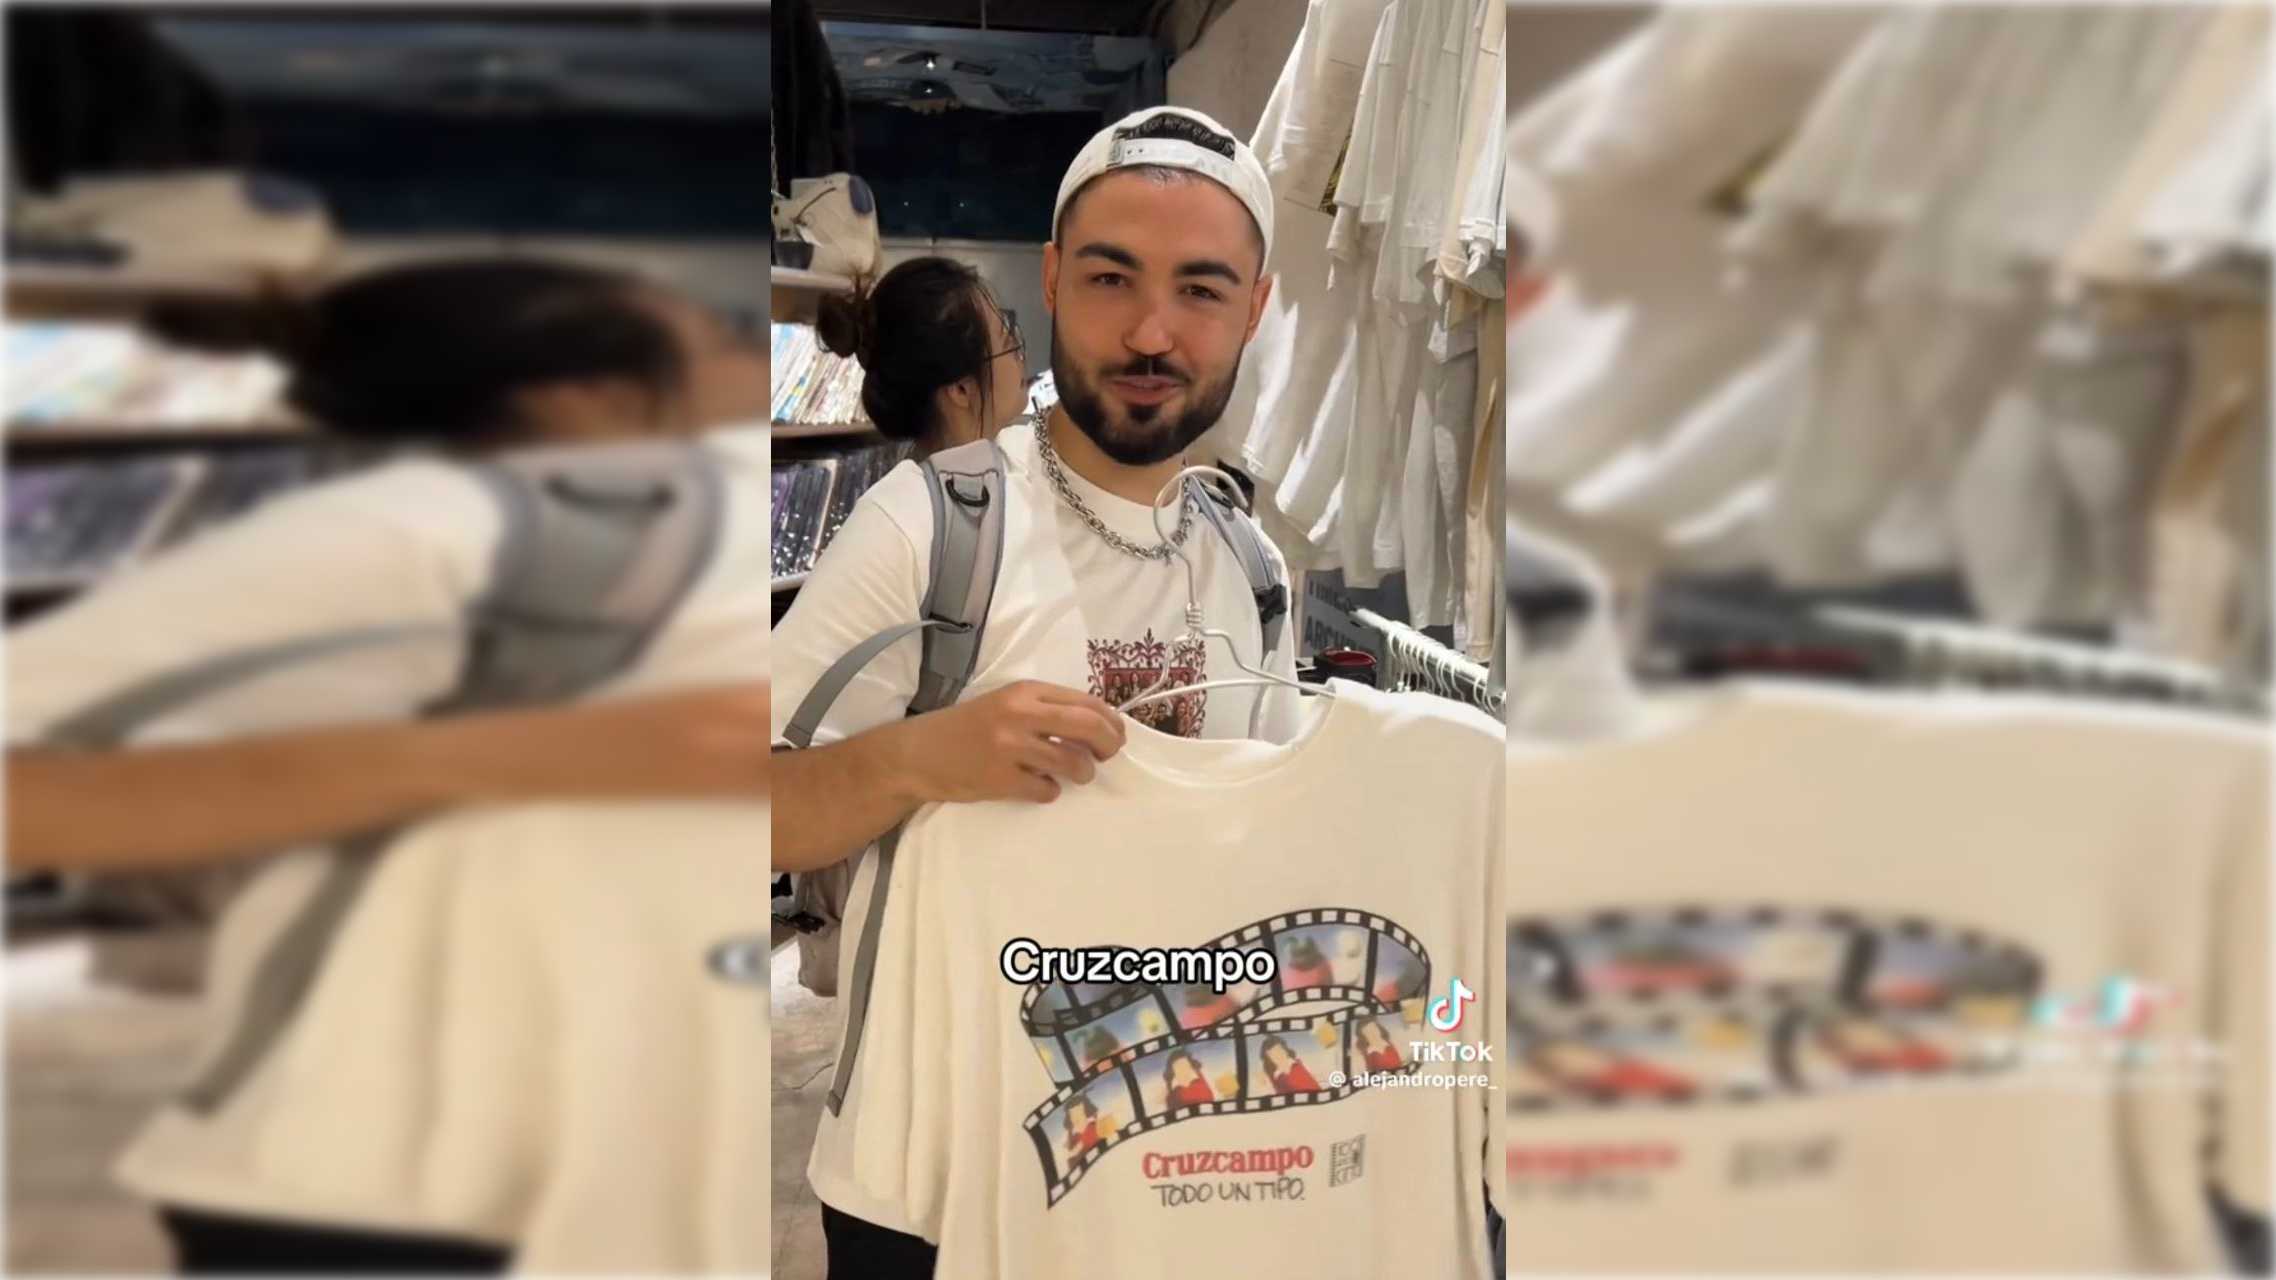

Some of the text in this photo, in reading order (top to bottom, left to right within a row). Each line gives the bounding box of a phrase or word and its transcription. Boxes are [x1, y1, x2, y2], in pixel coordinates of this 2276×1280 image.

[1142, 1145, 1314, 1179] Cruzcampo
[1150, 1182, 1213, 1207] TODO
[1218, 1181, 1251, 1201] UN
